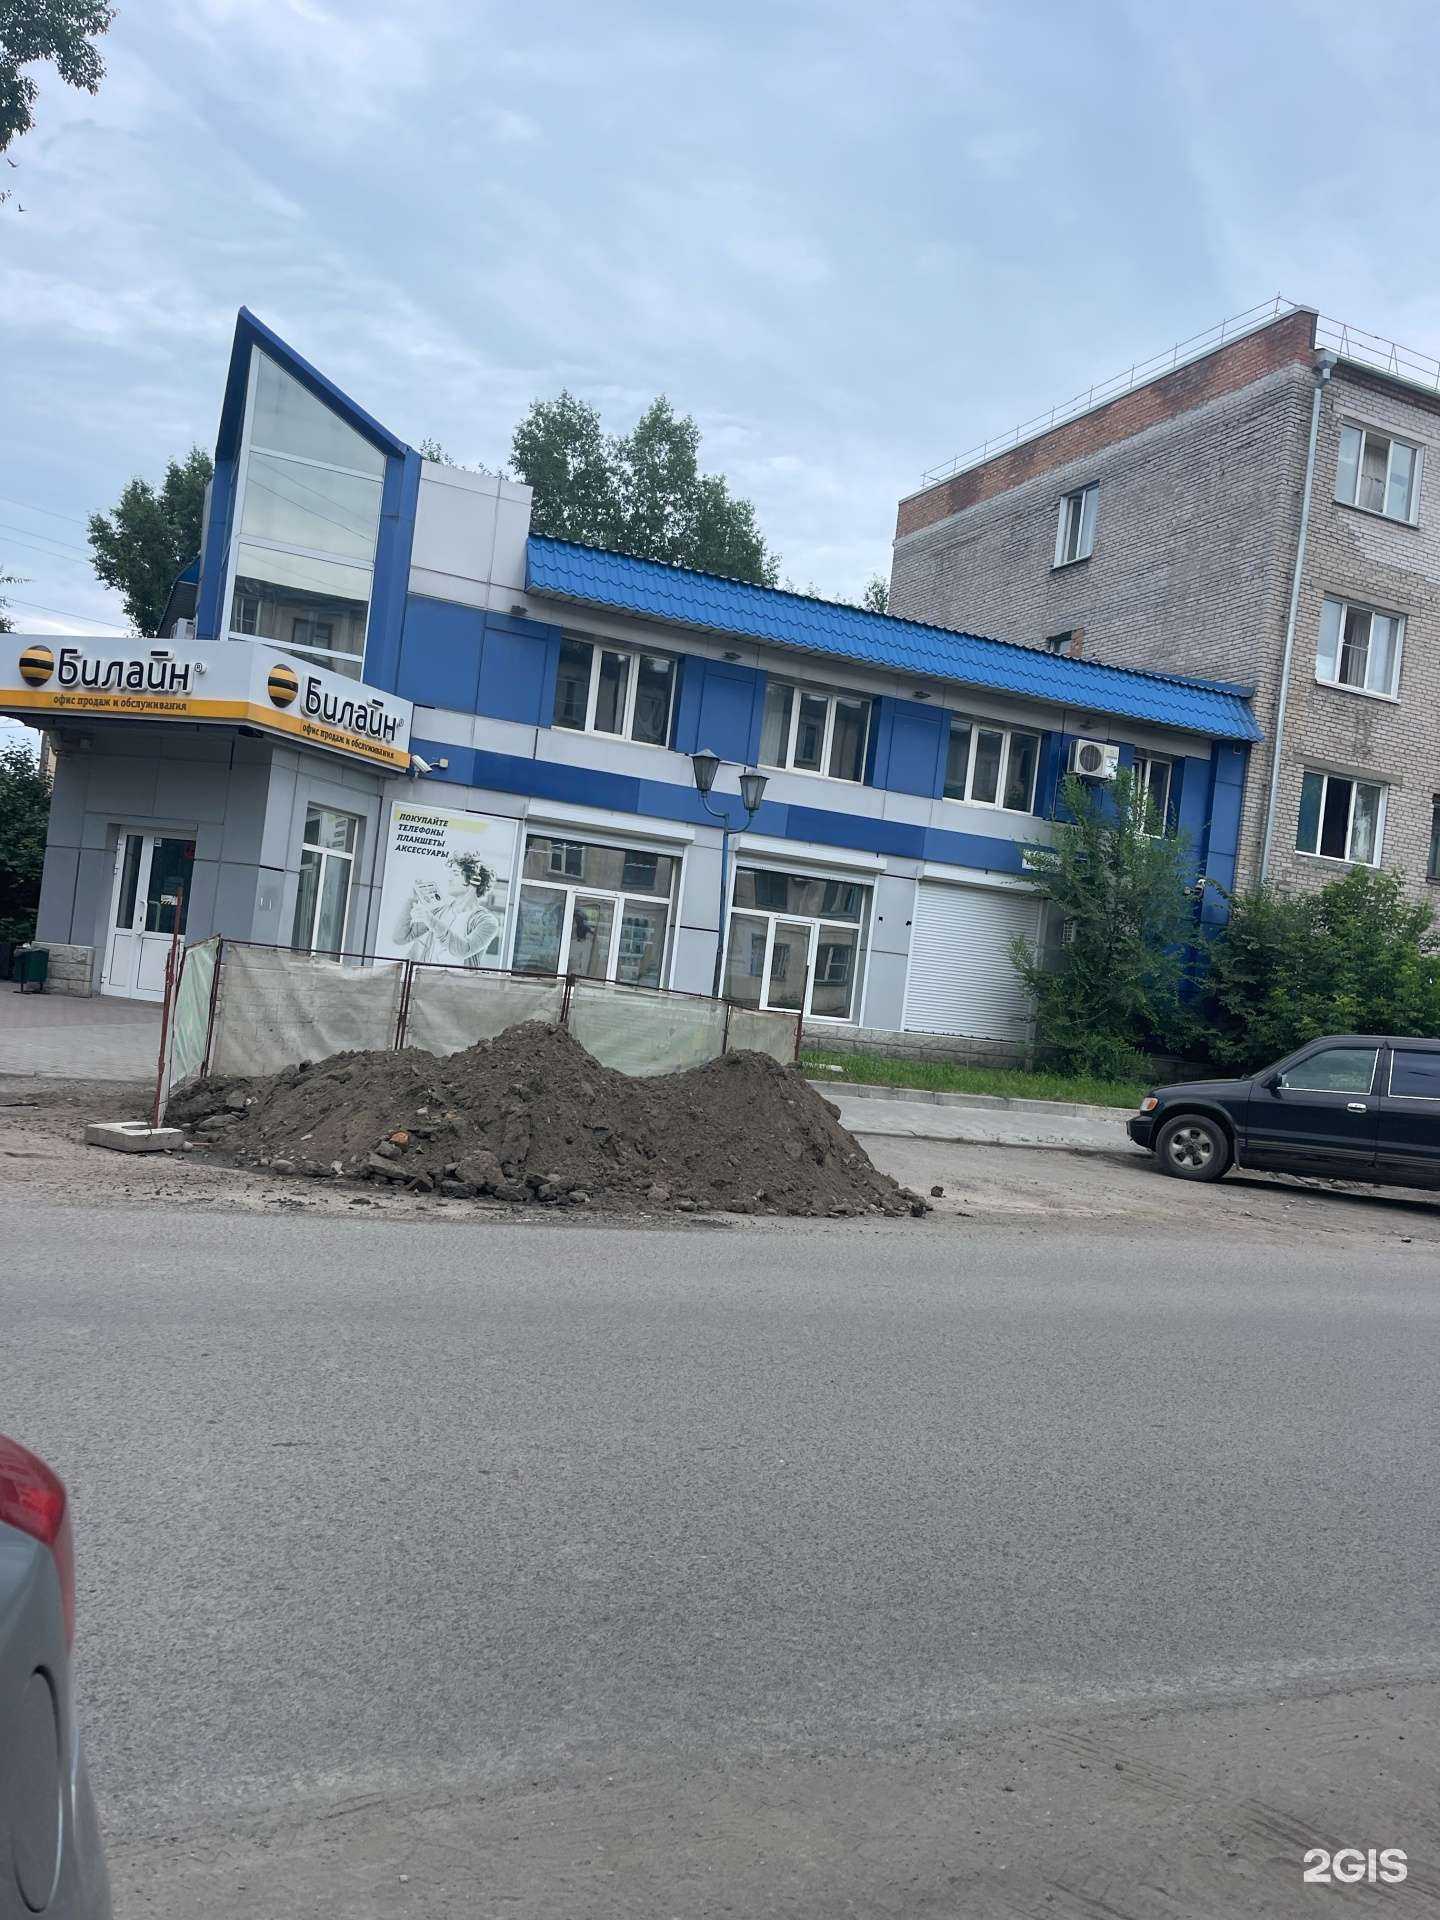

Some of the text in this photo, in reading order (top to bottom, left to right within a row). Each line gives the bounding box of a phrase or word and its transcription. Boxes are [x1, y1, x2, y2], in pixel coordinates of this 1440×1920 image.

[53, 696, 187, 711] офис продаж и обслуживания
[302, 723, 319, 736] офис
[320, 728, 345, 744] продаж
[351, 738, 394, 759] обслуживания
[399, 813, 449, 827] ПОКУПАЙТЕ
[398, 823, 444, 837] ТЕЛЕФОНЫ
[396, 834, 445, 848] ПЛАНШЕТЫ
[395, 844, 449, 858] АКСЕССУАРЫ
